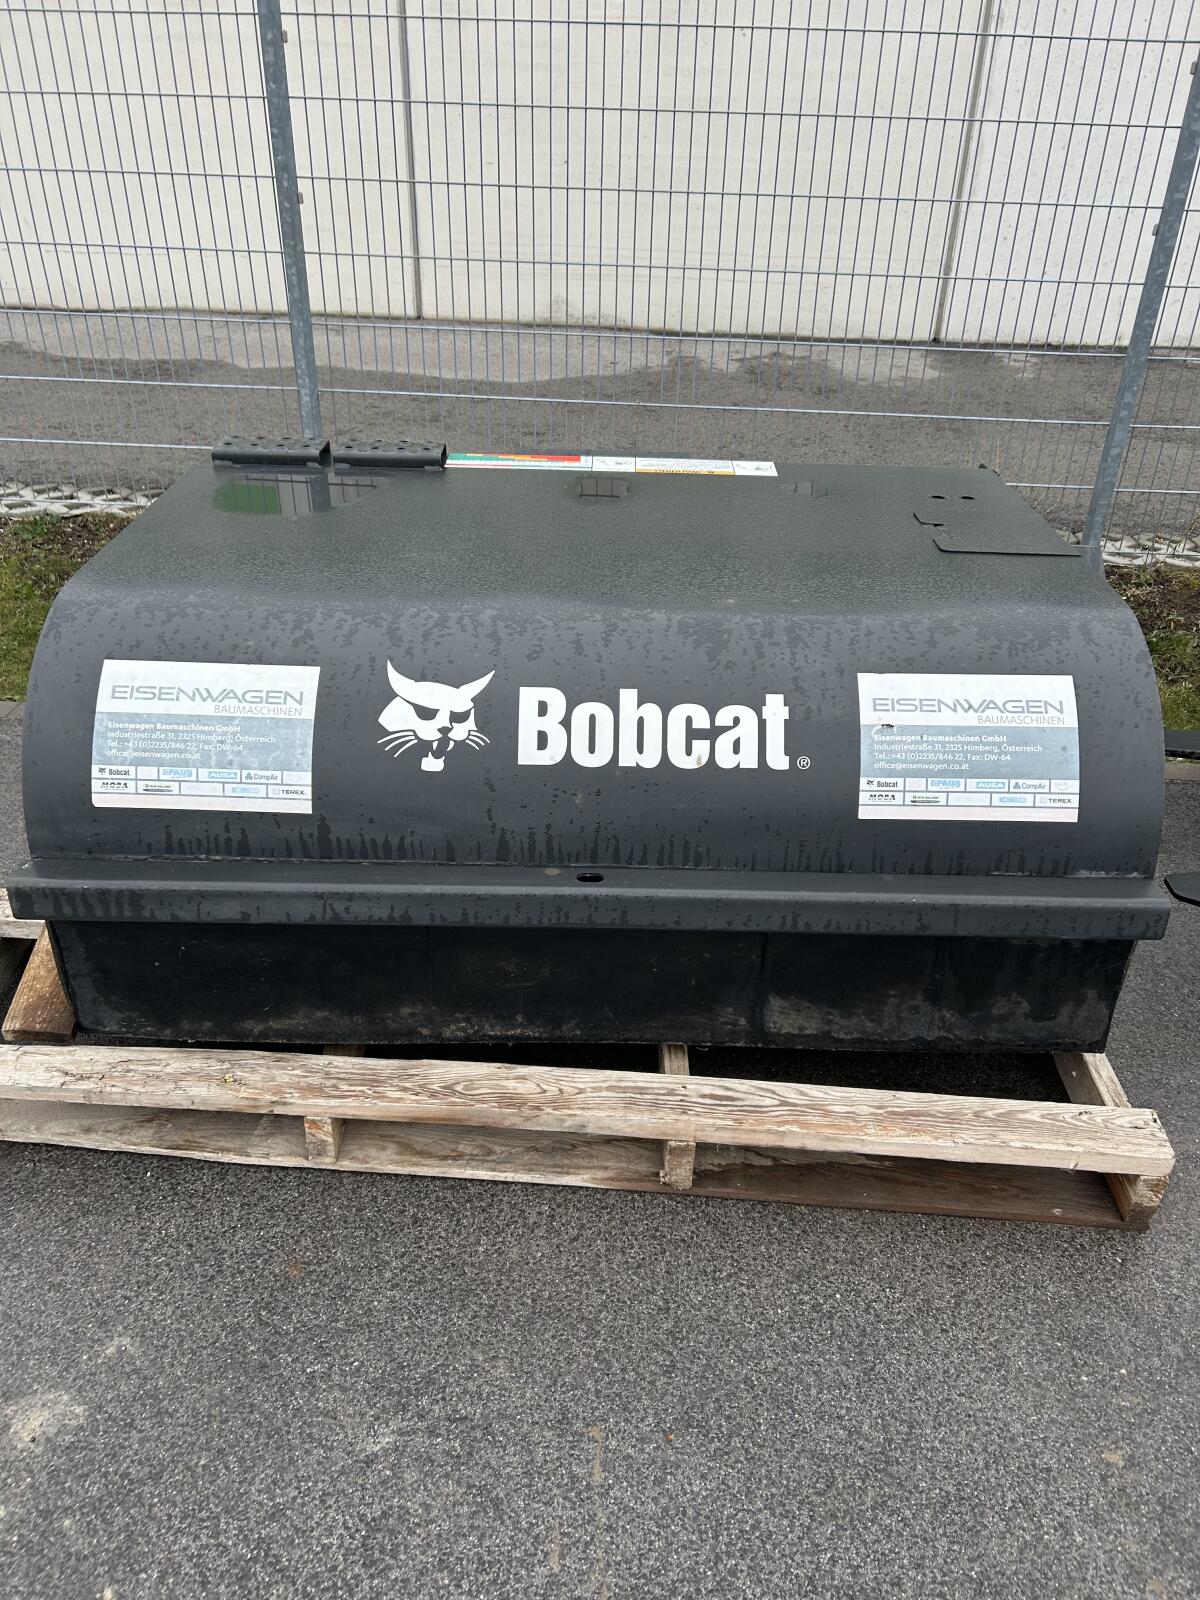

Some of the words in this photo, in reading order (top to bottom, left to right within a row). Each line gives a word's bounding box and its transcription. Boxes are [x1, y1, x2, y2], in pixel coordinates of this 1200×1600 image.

[111, 685, 304, 706] EISENWAGEN
[214, 705, 302, 717] BAUMASCHINEN
[872, 697, 1064, 715] EISENWAGEN
[977, 715, 1065, 725] BAUMASCHINEN
[108, 721, 154, 731] Eisenwagen
[156, 722, 214, 732] Baumaschinen
[215, 724, 241, 732] GmbH
[517, 686, 790, 770] Bobcat
[107, 731, 166, 740] Industriestraße
[179, 732, 196, 740] 2325
[234, 734, 276, 743] Österreich
[874, 734, 921, 743] Eisenwagen
[922, 734, 980, 742] Baumaschinen
[199, 743, 215, 751] Fax:
[874, 743, 933, 751] Industriestraße
[934, 744, 944, 752] 31,
[945, 743, 962, 751] 2325
[964, 744, 1000, 753] Himberg,
[1001, 743, 1043, 752] Österreich
[105, 750, 201, 760] office@eisenwagen.co.at
[967, 753, 983, 761] Fax:
[984, 753, 1011, 761] DW-64
[874, 762, 970, 771] office@eisenwagen.co.at
[108, 768, 130, 777] Bobcat
[253, 773, 278, 781] CompAir
[876, 780, 898, 788] Bobcat
[1021, 782, 1046, 791] CompAir
